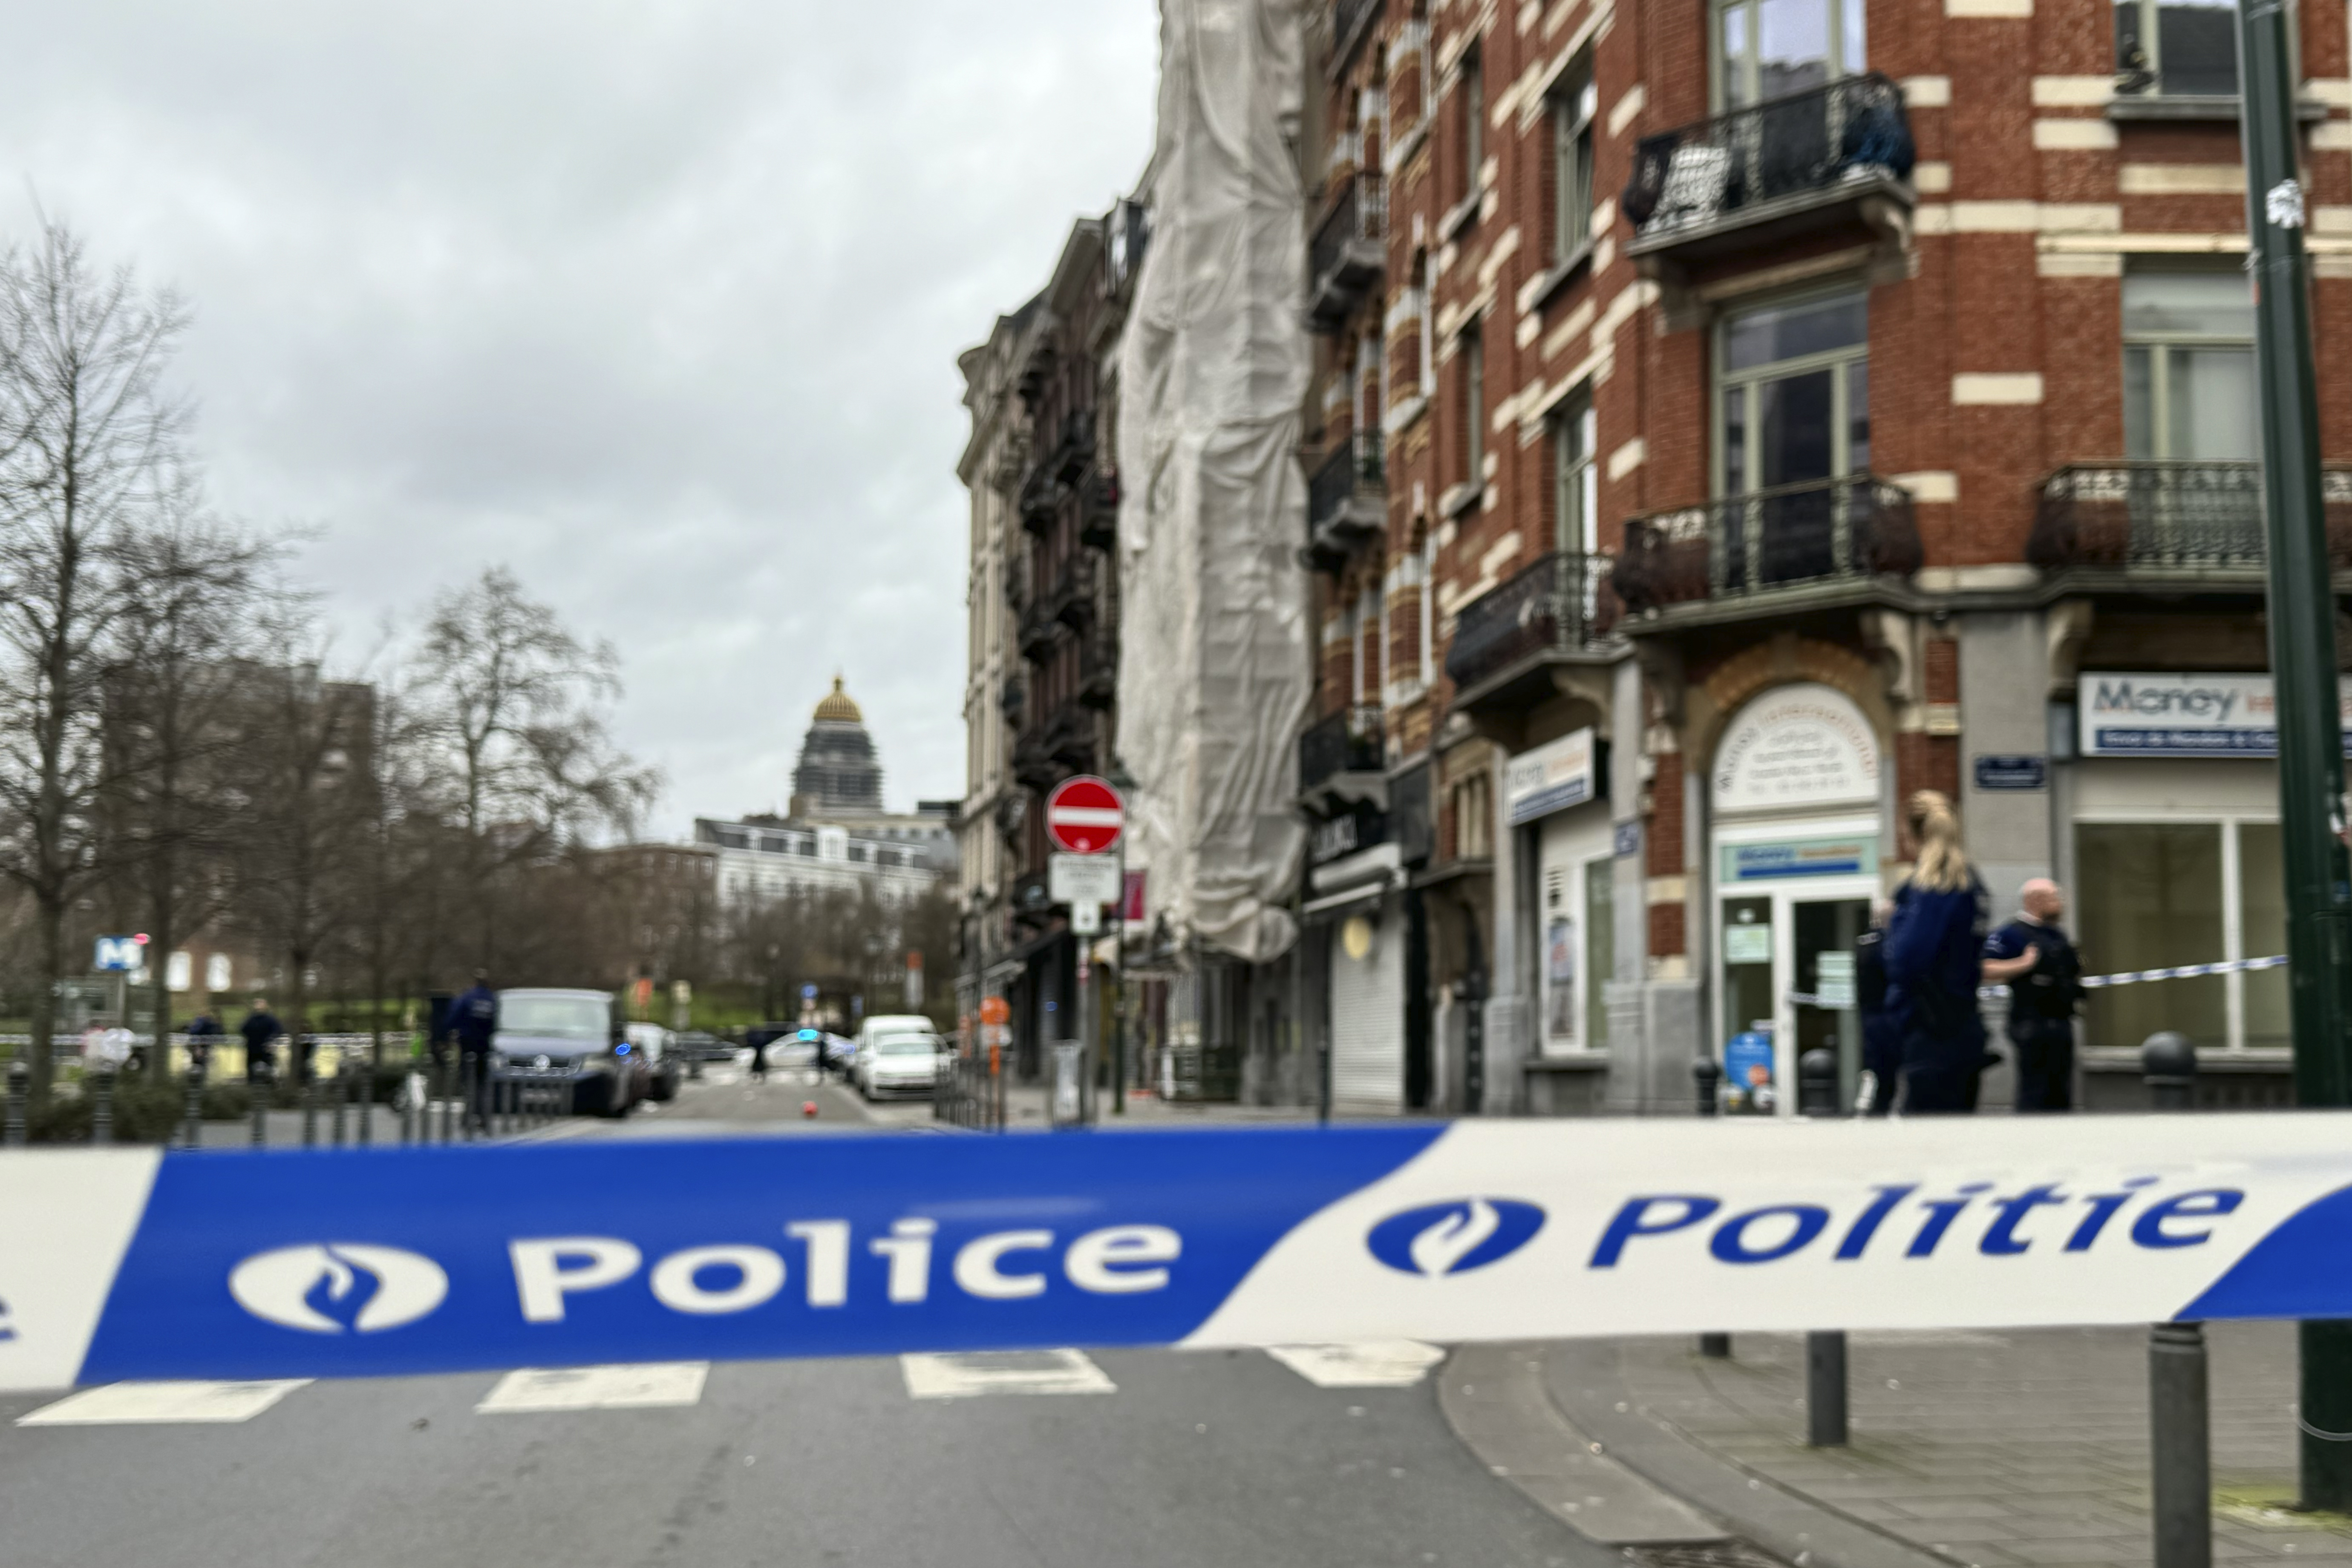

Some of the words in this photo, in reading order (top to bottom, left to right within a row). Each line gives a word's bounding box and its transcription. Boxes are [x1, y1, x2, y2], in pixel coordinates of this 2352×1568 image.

[97, 937, 143, 969] M
[510, 1217, 1183, 1323] Police
[1588, 1177, 2245, 1271] Politie
